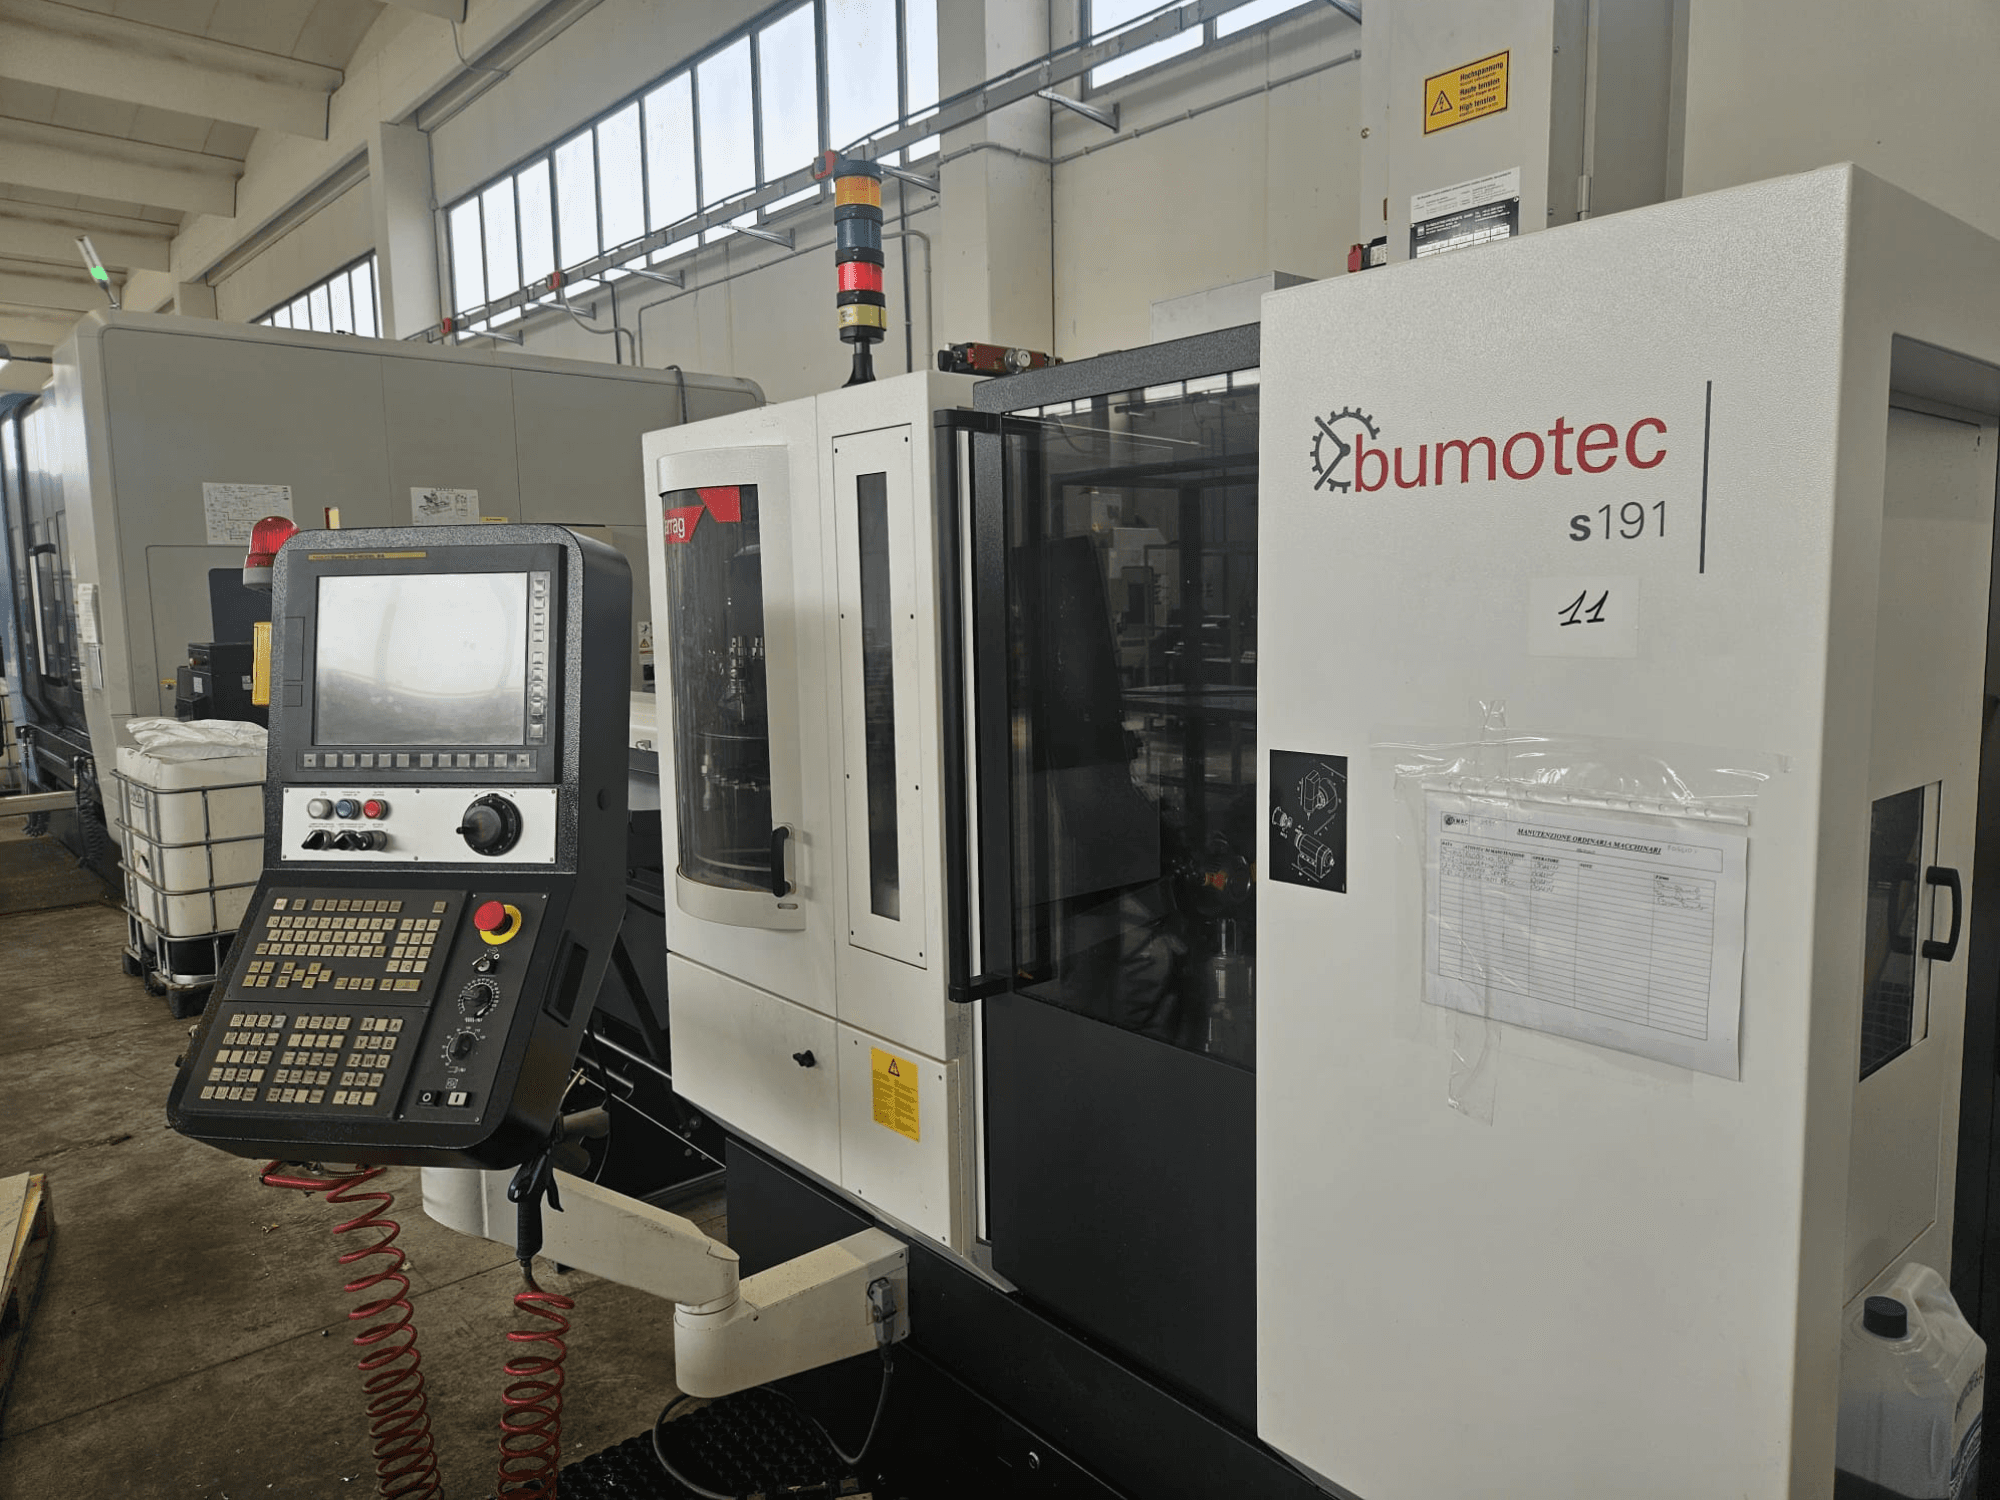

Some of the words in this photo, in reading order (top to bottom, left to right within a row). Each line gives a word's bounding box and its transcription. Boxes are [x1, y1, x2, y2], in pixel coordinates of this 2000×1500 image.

[1355, 415, 1668, 493] bumotec
[1569, 500, 1667, 541] s191
[1558, 590, 1609, 626] 11
[1517, 828, 1571, 842] MANUTENZIONE
[1572, 835, 1612, 848] ORDINARIA
[1613, 841, 1662, 855] MACCHINARI
